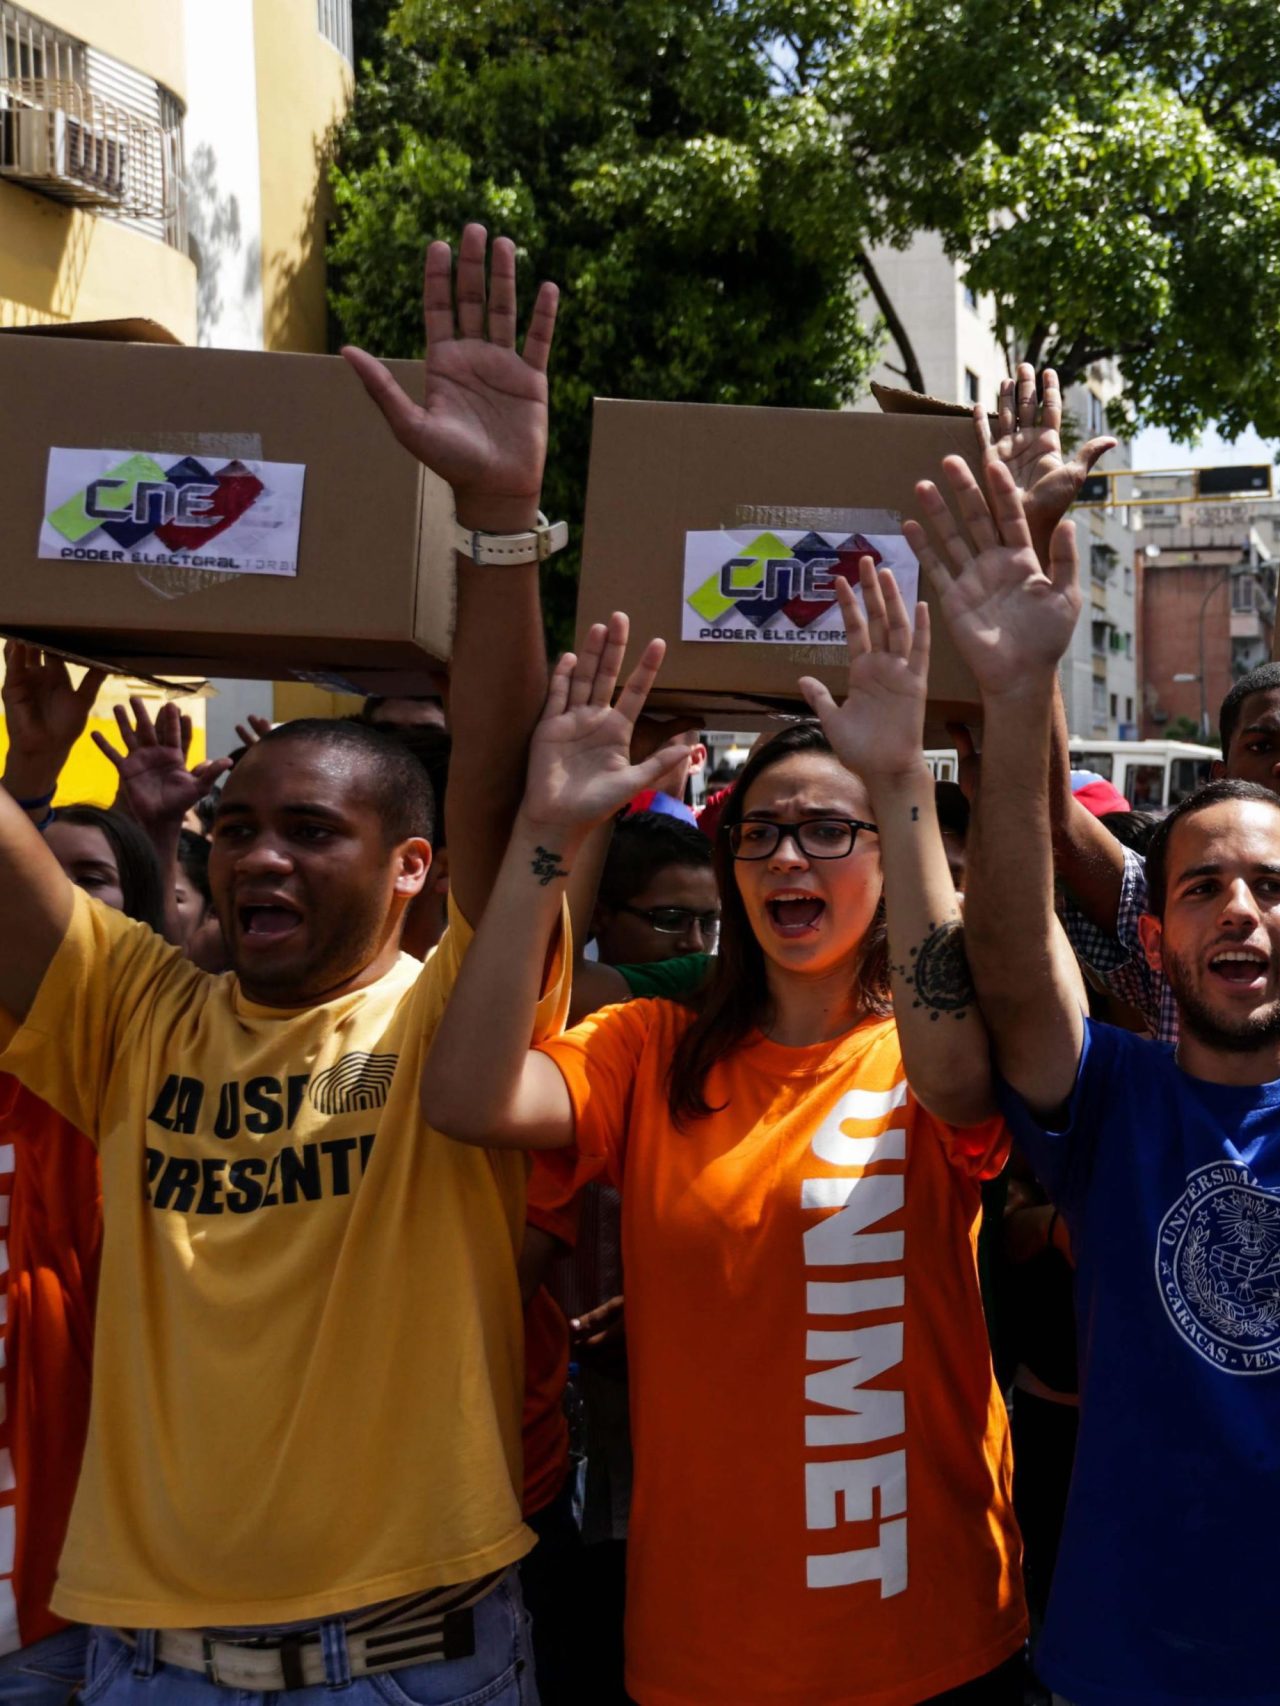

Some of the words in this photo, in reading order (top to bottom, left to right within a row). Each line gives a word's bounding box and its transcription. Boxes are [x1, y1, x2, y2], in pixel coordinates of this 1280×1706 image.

[84, 478, 226, 527] CNE
[60, 547, 124, 563] PODER
[131, 552, 241, 570] ELECTORAL
[719, 556, 842, 602] CNE
[699, 627, 756, 641] PODER
[762, 628, 848, 642] ELECTOR
[147, 1073, 205, 1135] LA
[801, 1078, 909, 1600] UNIMET
[1165, 1281, 1229, 1364] CARACAS
